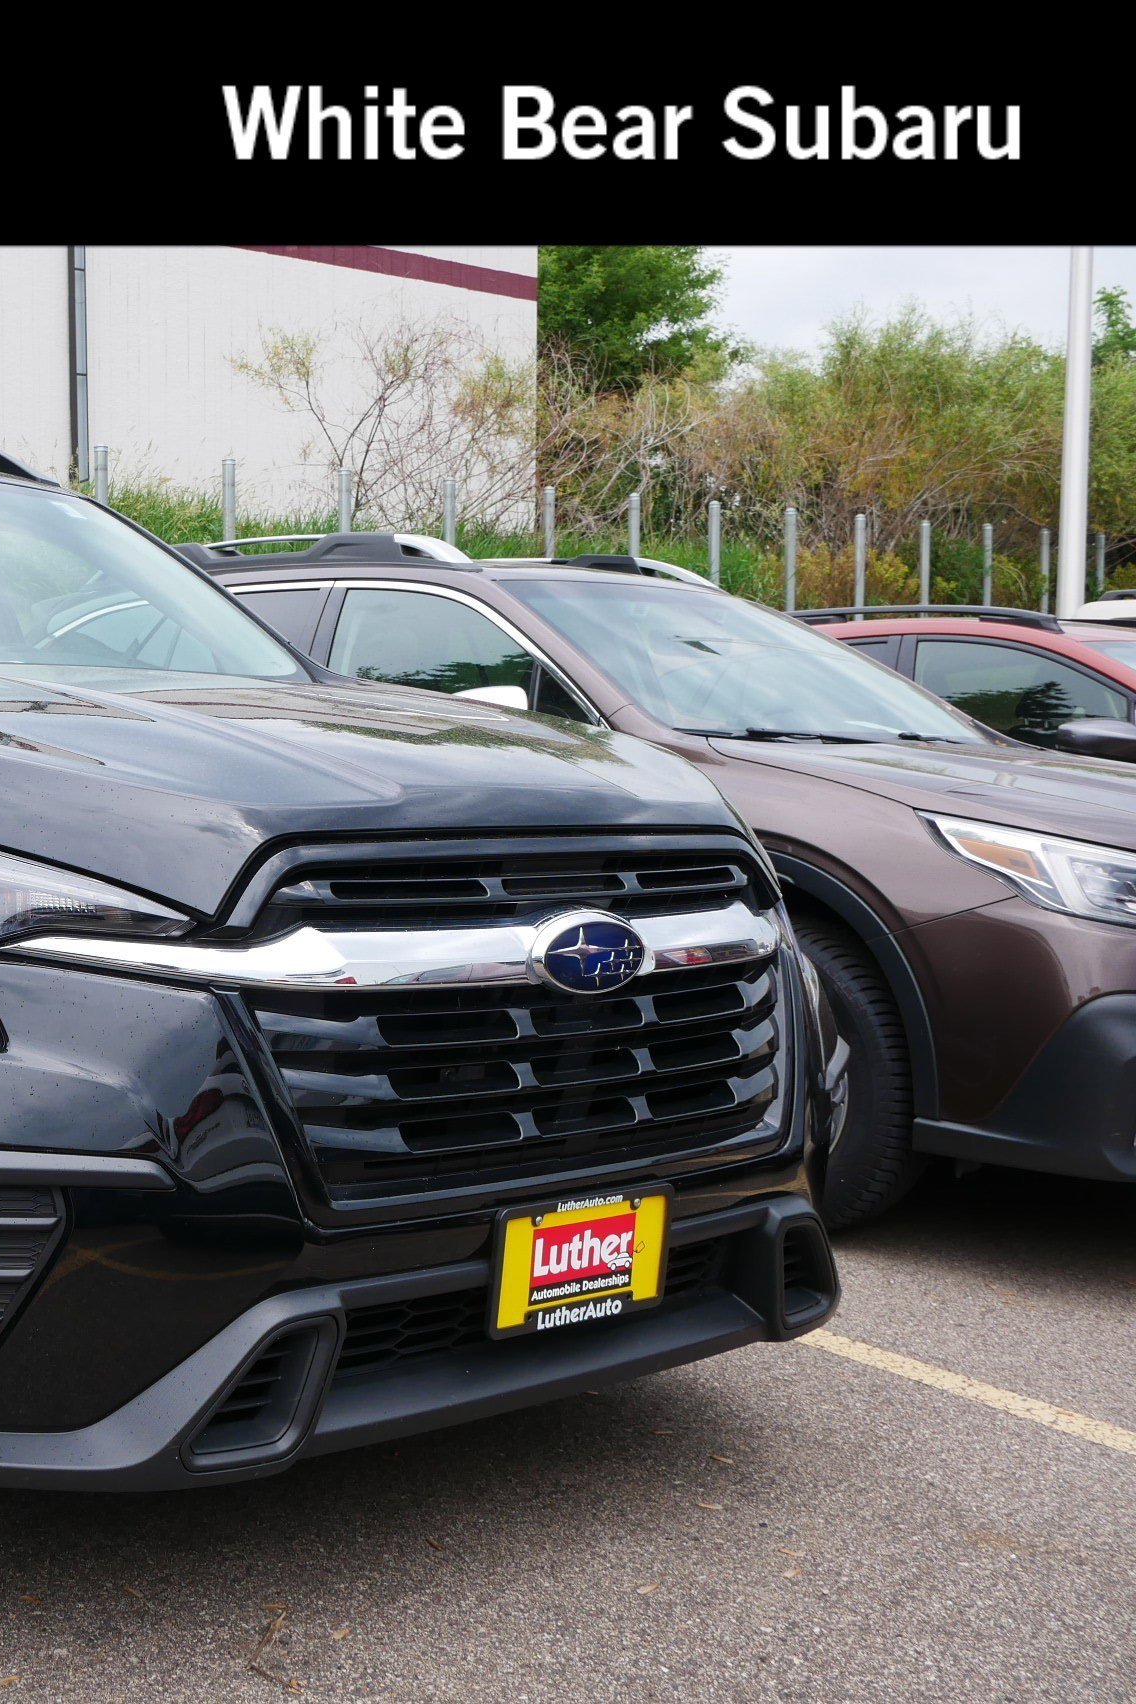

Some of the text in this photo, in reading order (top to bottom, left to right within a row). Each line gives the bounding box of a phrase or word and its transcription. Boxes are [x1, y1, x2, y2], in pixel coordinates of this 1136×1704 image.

[556, 1194, 624, 1213] LutherAuto.com
[533, 1229, 634, 1278] Luther
[530, 1273, 630, 1302] Automobile Dealerships
[536, 1299, 623, 1331] LutherAuto
